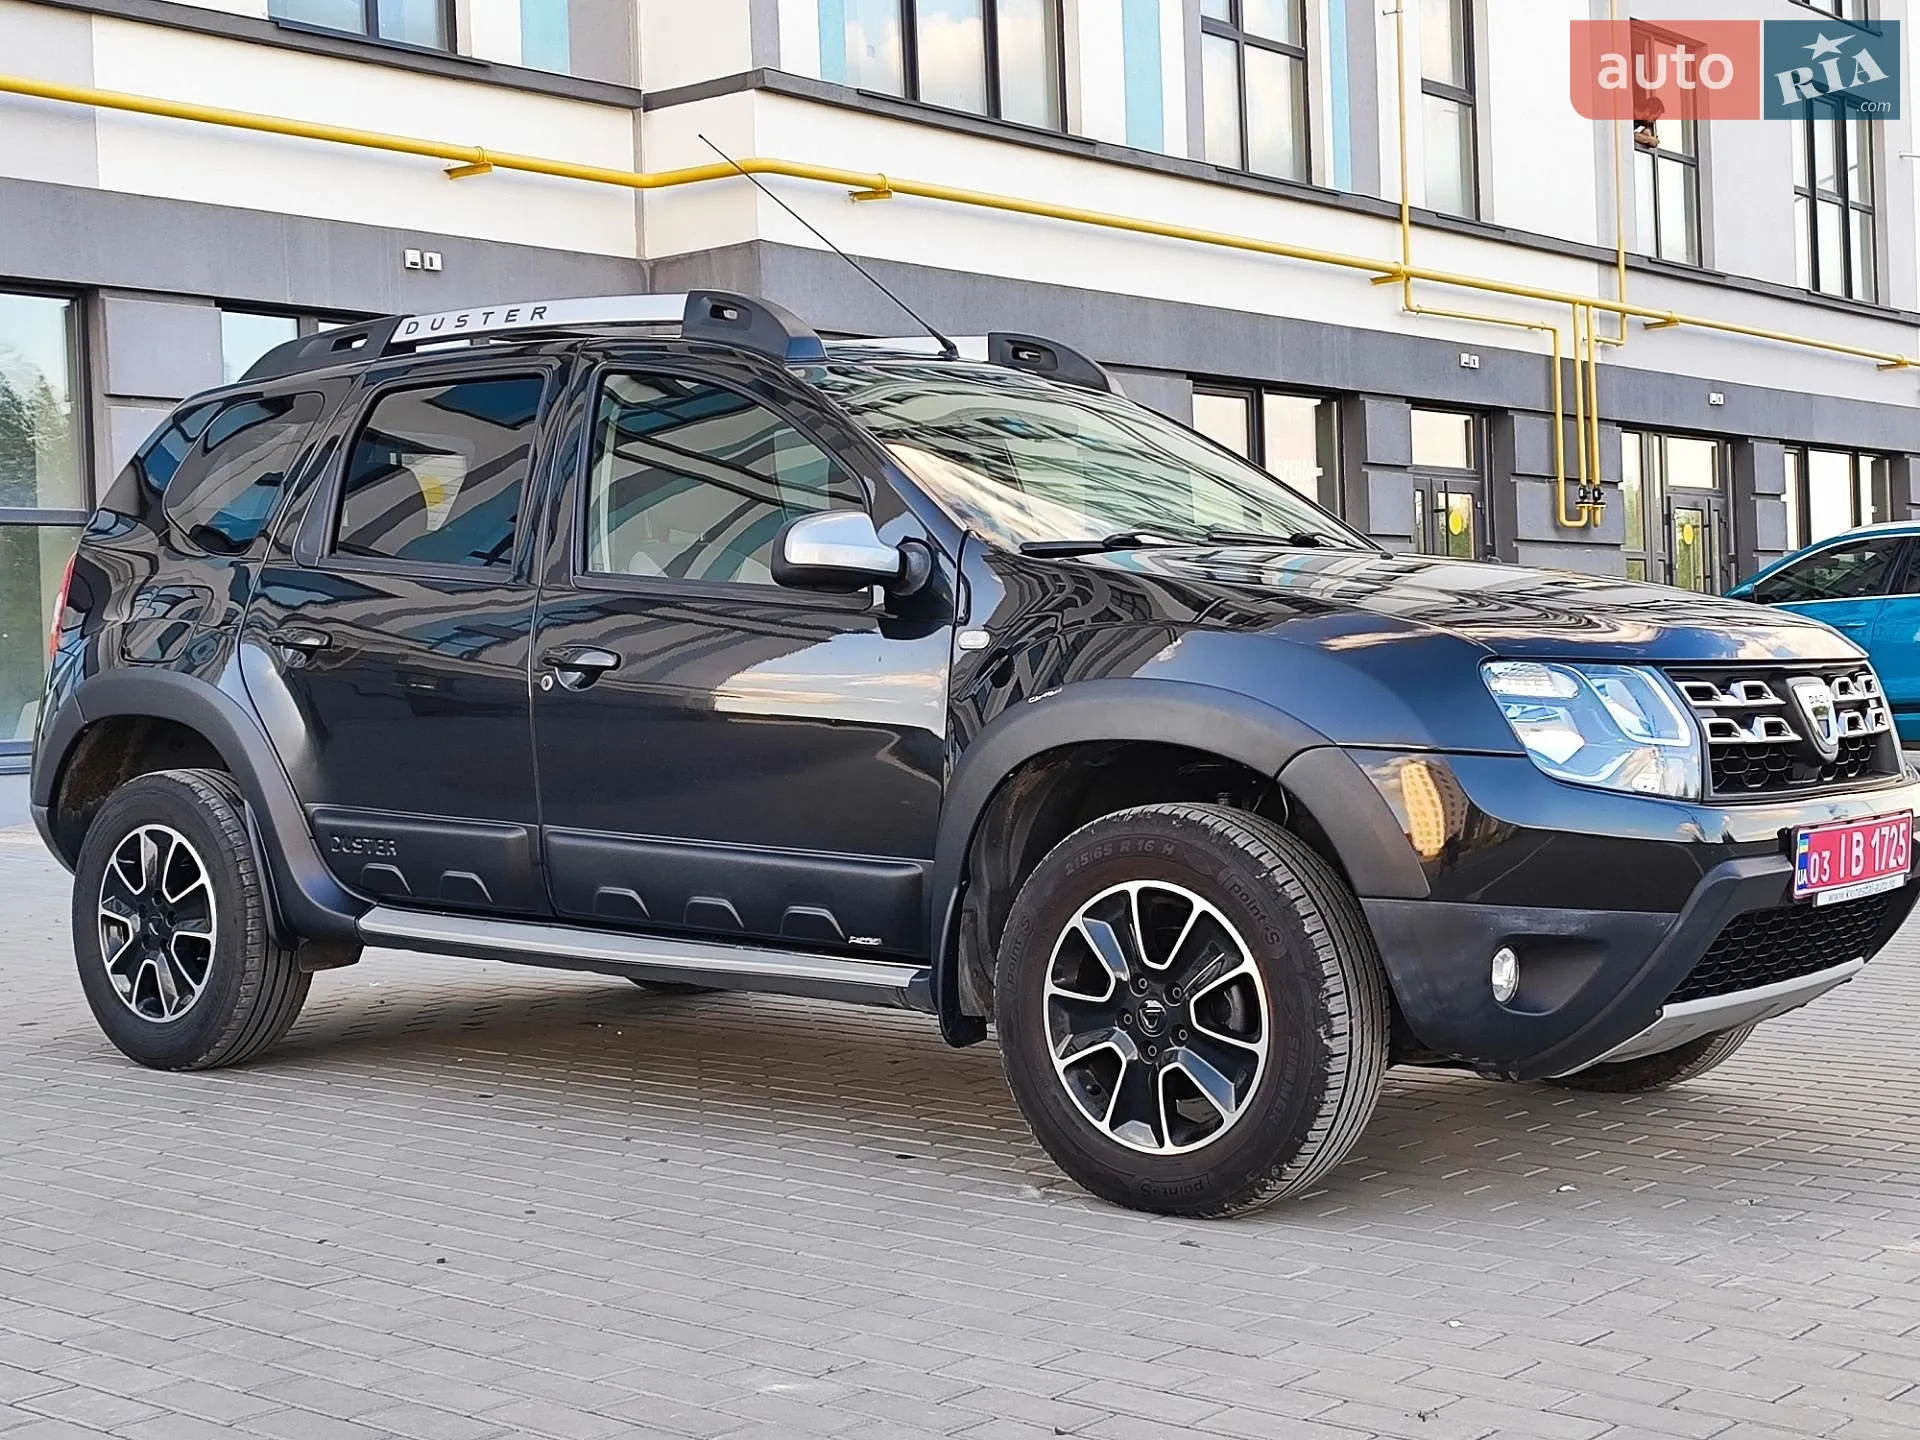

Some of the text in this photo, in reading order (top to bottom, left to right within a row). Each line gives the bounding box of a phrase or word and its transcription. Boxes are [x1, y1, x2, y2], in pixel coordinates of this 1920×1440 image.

[405, 305, 548, 336] DUSTER
[330, 835, 398, 857] DUSTER
[1119, 839, 1131, 853] R
[1136, 839, 1156, 853] 16
[1161, 842, 1176, 856] H
[1809, 822, 1908, 885] 03 IB 1725
[1797, 868, 1808, 886] UA
